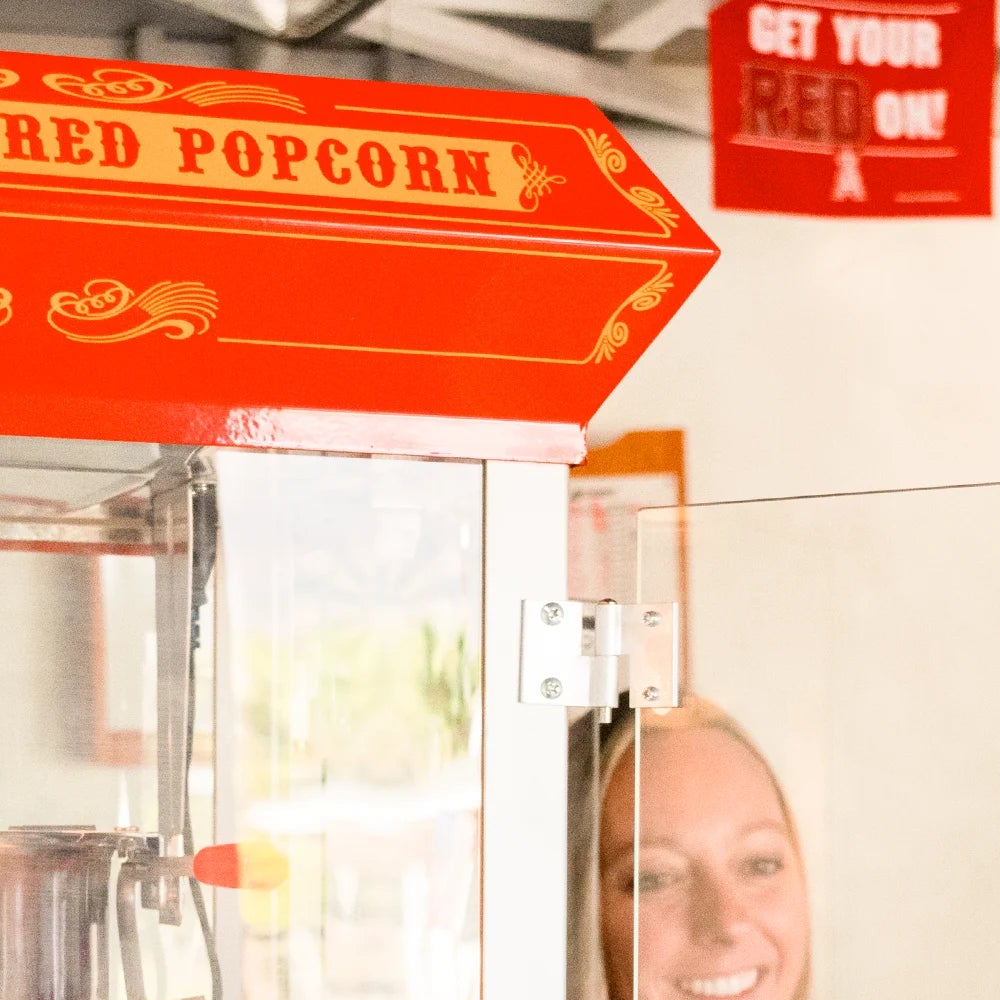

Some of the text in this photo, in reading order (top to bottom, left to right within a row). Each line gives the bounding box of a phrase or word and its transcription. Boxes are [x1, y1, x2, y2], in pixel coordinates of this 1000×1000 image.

[749, 5, 943, 68] GET YOUR
[172, 127, 497, 197] POPCORN
